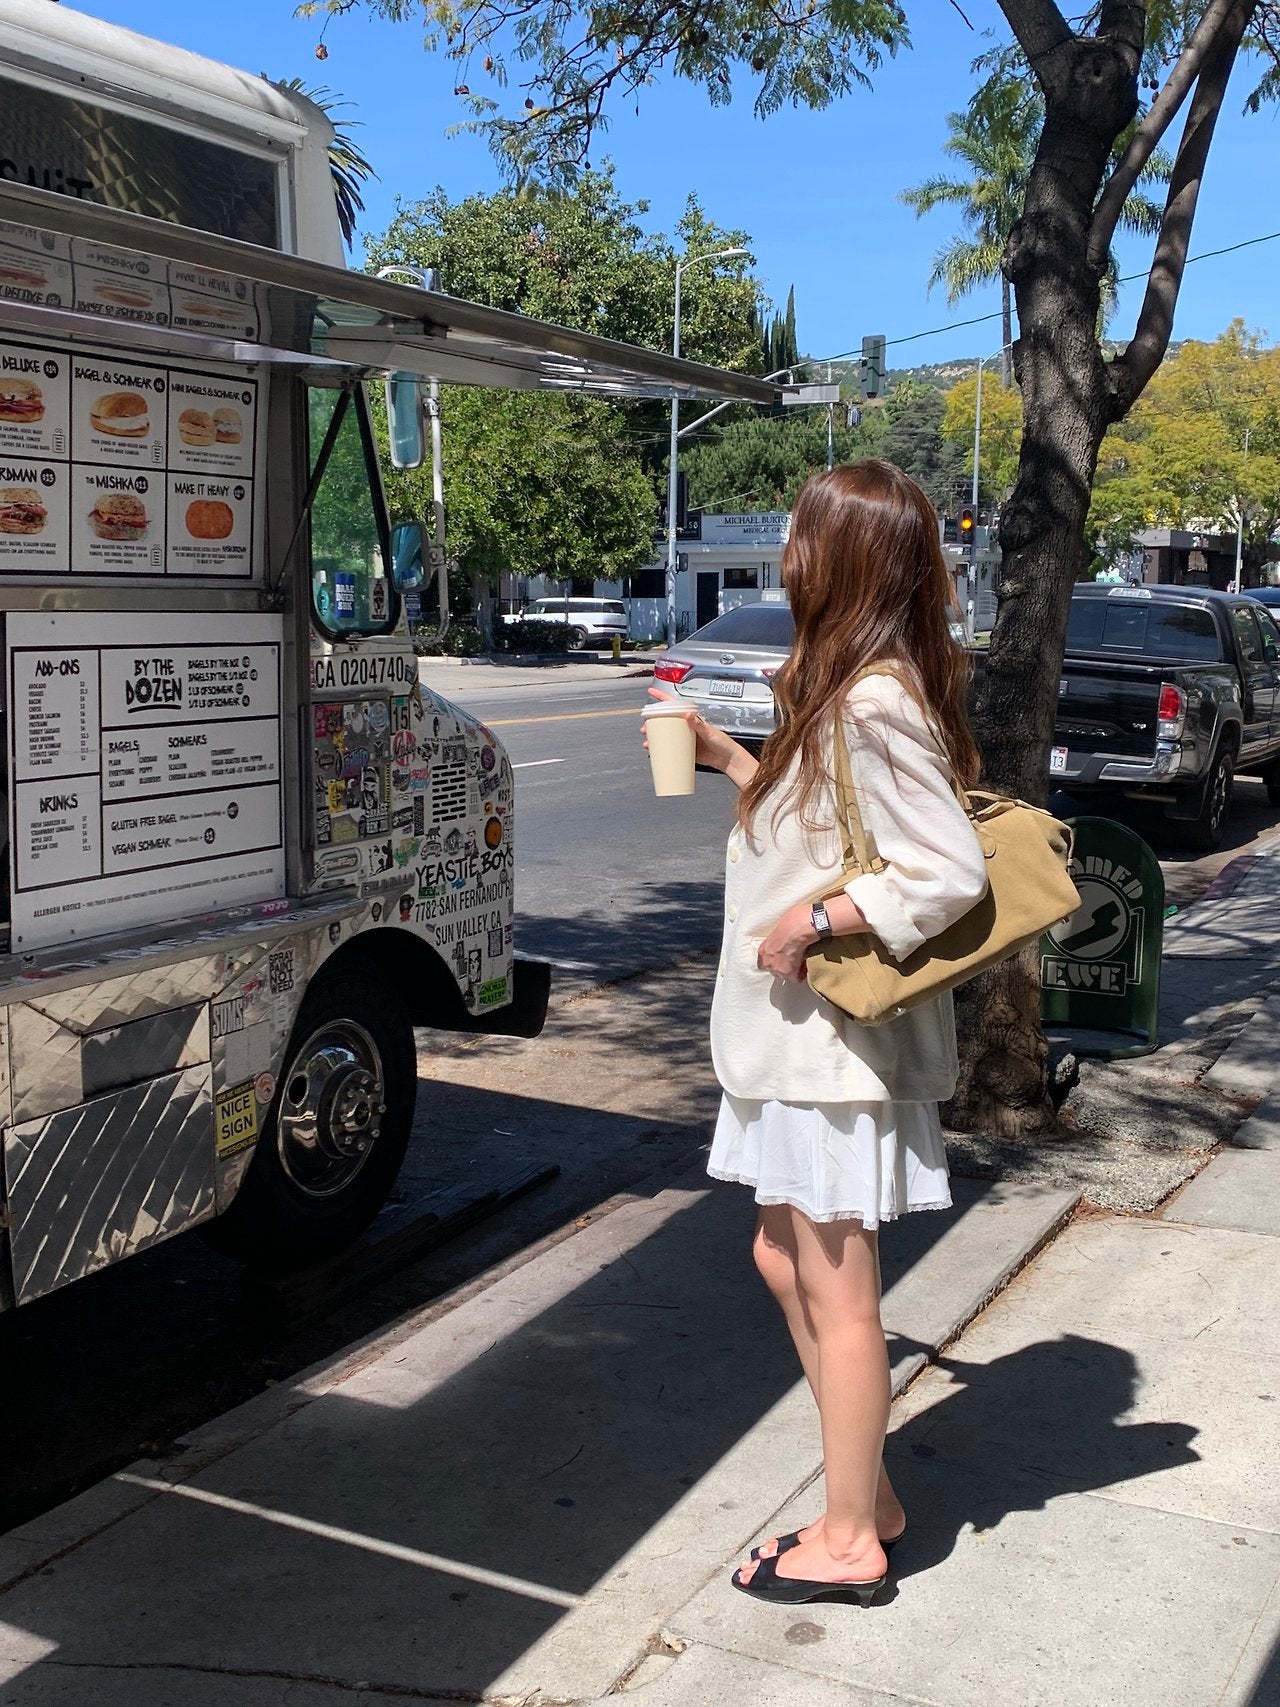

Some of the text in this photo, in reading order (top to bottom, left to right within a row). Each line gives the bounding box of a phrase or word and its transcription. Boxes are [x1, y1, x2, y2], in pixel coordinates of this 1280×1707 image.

[3, 356, 40, 373] DELUXE
[75, 367, 101, 381] BAGEL
[103, 372, 111, 383] &
[113, 373, 152, 389] SCHMEAR
[186, 385, 206, 396] BAGELS
[213, 389, 240, 400] SCHMEAR
[96, 475, 134, 490] MISHKA
[175, 483, 230, 496] MAKE IT HEAVY
[724, 516, 759, 524] MICHAEL
[35, 659, 80, 677] ADD-ONS
[134, 659, 174, 676] BY THE
[316, 656, 404, 688] CA 0204740
[126, 677, 181, 705] DOZEN
[393, 706, 408, 735] 15
[109, 740, 139, 753] BAGELS
[168, 735, 207, 748] SCHMEARS
[40, 793, 78, 813] DRINKS
[111, 819, 138, 831] GLUTEN
[140, 816, 156, 827] FREE
[158, 814, 177, 824] BAGEL
[112, 842, 136, 855] VEGAN
[138, 838, 171, 851] SCHMEAR
[481, 850, 514, 874] BOYS
[33, 902, 80, 918] ALLERGEN NOTICE
[415, 900, 436, 922] 7782
[439, 894, 457, 916] SAN
[460, 883, 502, 910] FERNANDO
[436, 923, 453, 946] SUN
[491, 910, 501, 929] CA
[269, 949, 293, 964] SPRAY
[270, 959, 293, 971] PAINT
[270, 969, 293, 983] NOT
[1047, 961, 1120, 991] EWE
[270, 980, 293, 994] WEED
[221, 1095, 250, 1119] NICE
[222, 1114, 253, 1139] SIGN
